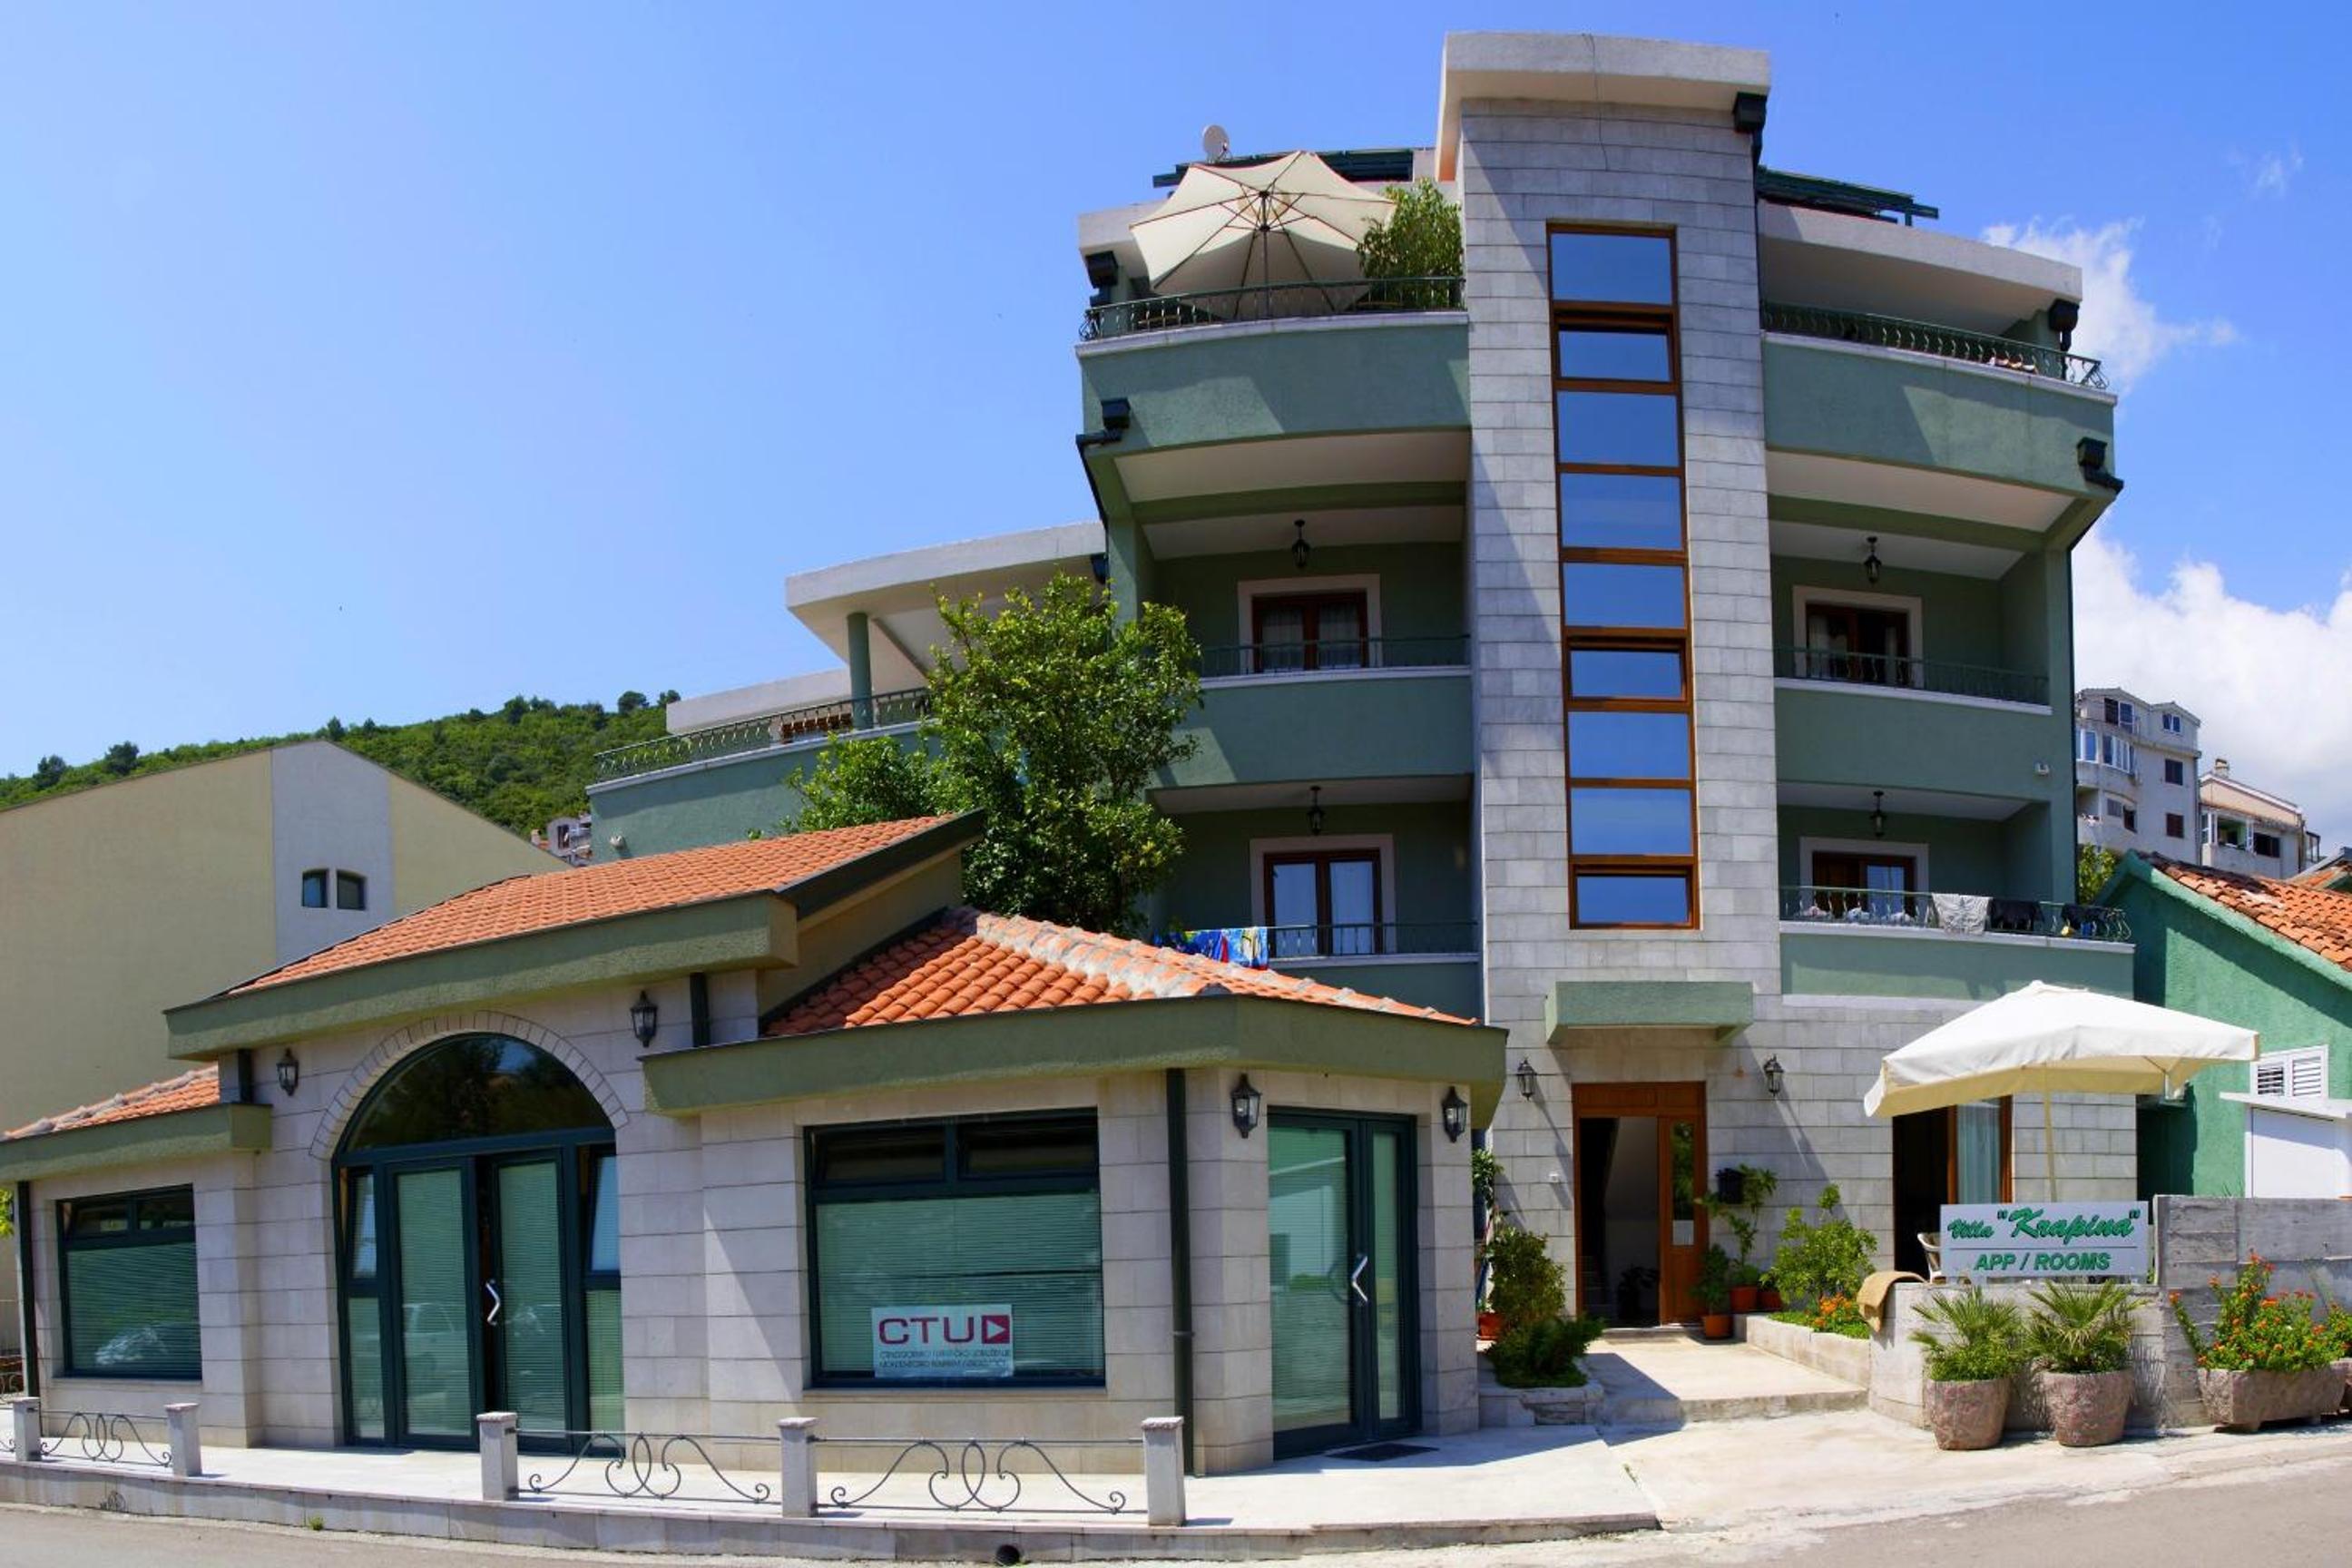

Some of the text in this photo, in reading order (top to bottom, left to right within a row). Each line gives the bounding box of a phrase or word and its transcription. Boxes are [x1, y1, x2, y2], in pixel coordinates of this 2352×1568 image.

[1947, 1219, 1994, 1240] Villa
[1975, 1253, 2016, 1270] APP
[2034, 1252, 2112, 1270] ROOMS
[878, 1316, 975, 1344] CTU
